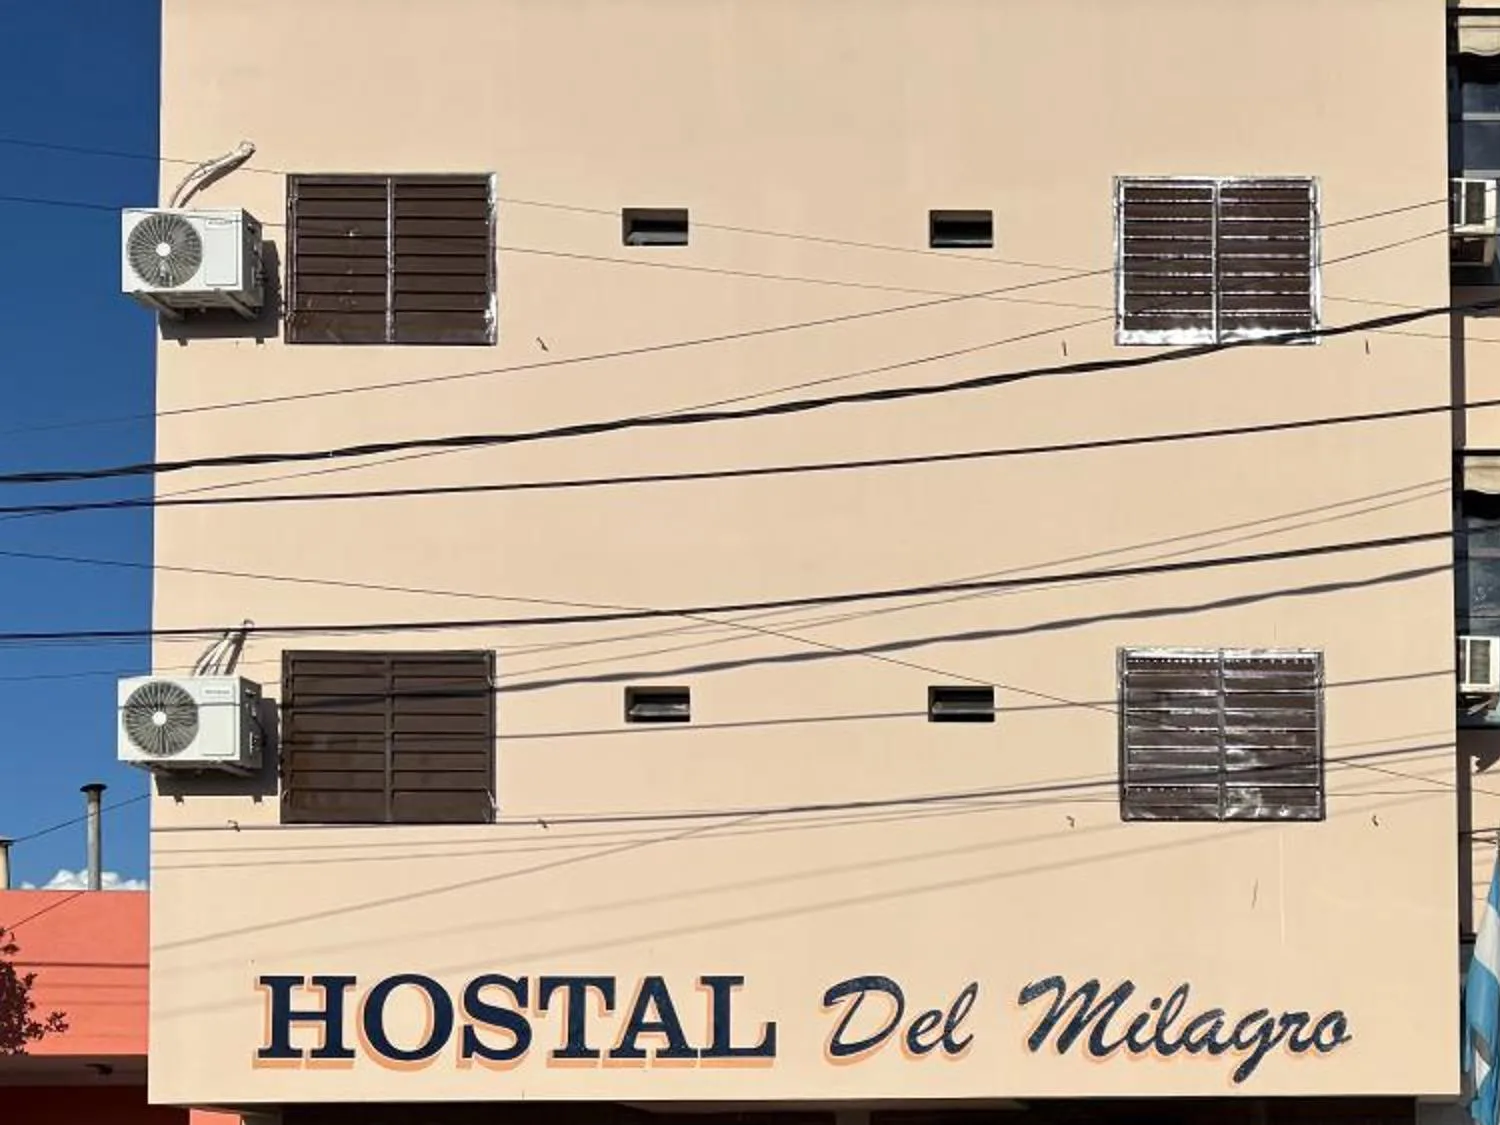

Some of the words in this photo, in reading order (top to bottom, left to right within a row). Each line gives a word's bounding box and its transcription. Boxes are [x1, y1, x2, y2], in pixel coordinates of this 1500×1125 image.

[254, 973, 776, 1066] HOSTAL
[822, 974, 979, 1060] Del
[1016, 974, 1353, 1084] Milagro
